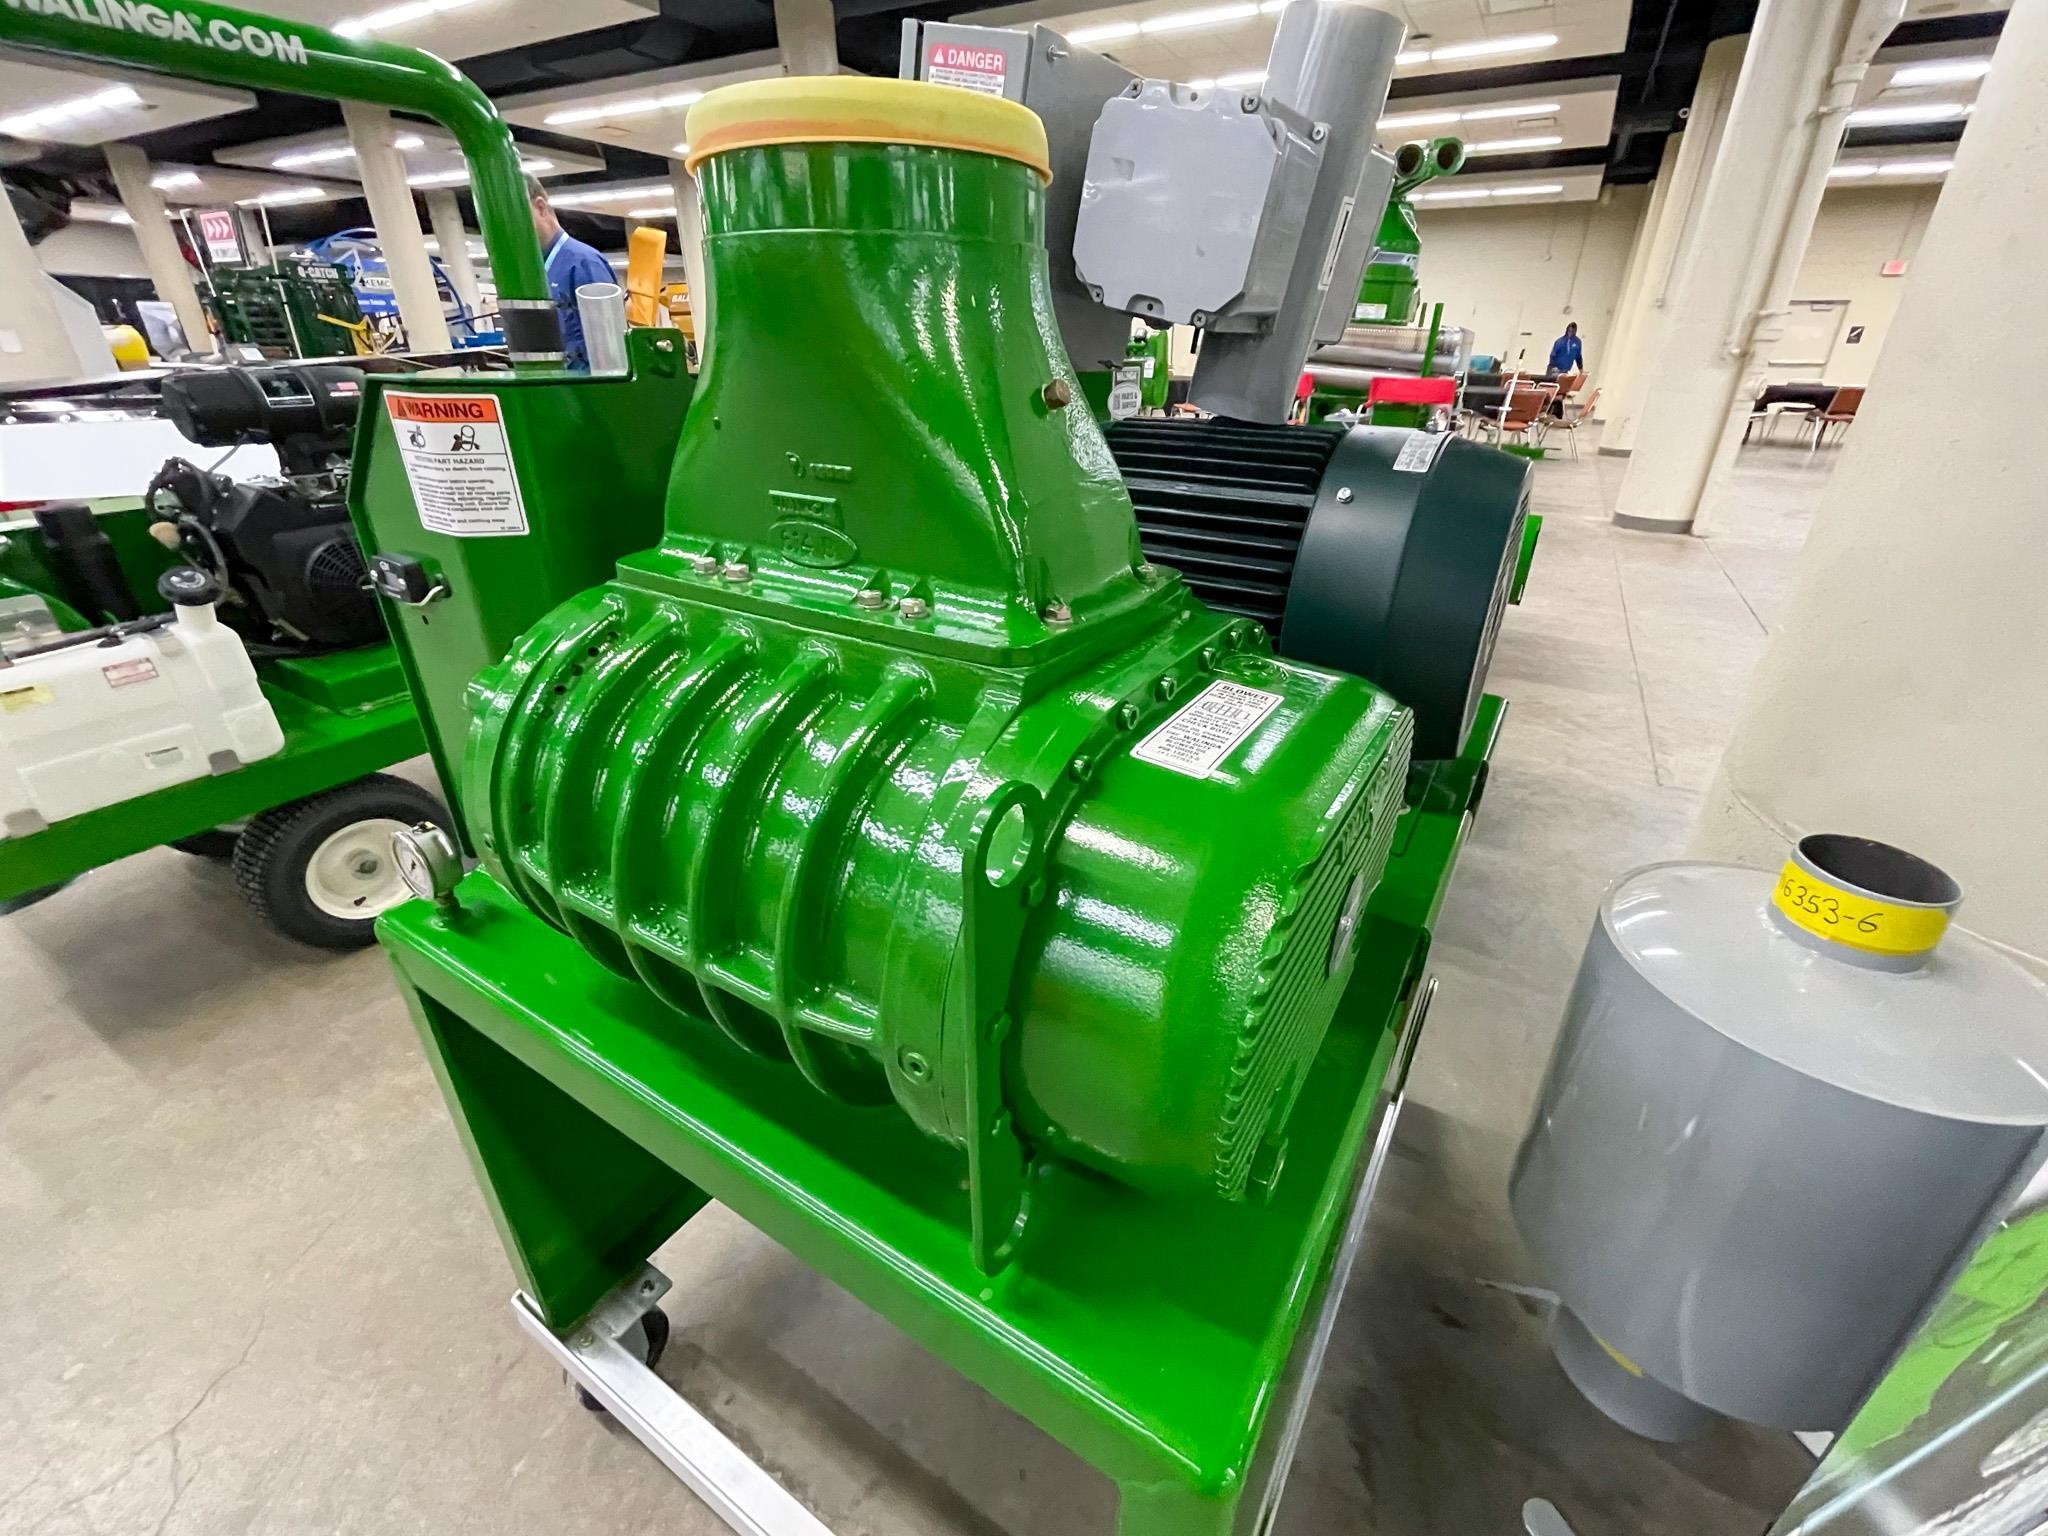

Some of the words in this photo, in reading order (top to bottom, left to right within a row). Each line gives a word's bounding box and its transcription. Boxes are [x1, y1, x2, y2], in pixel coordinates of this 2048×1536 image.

[948, 49, 1003, 71] DANGER
[404, 401, 484, 418] WARNING
[1221, 685, 1269, 700] BLOWER
[1182, 735, 1222, 749] WALINGA
[1781, 873, 1884, 933] 6353-6
